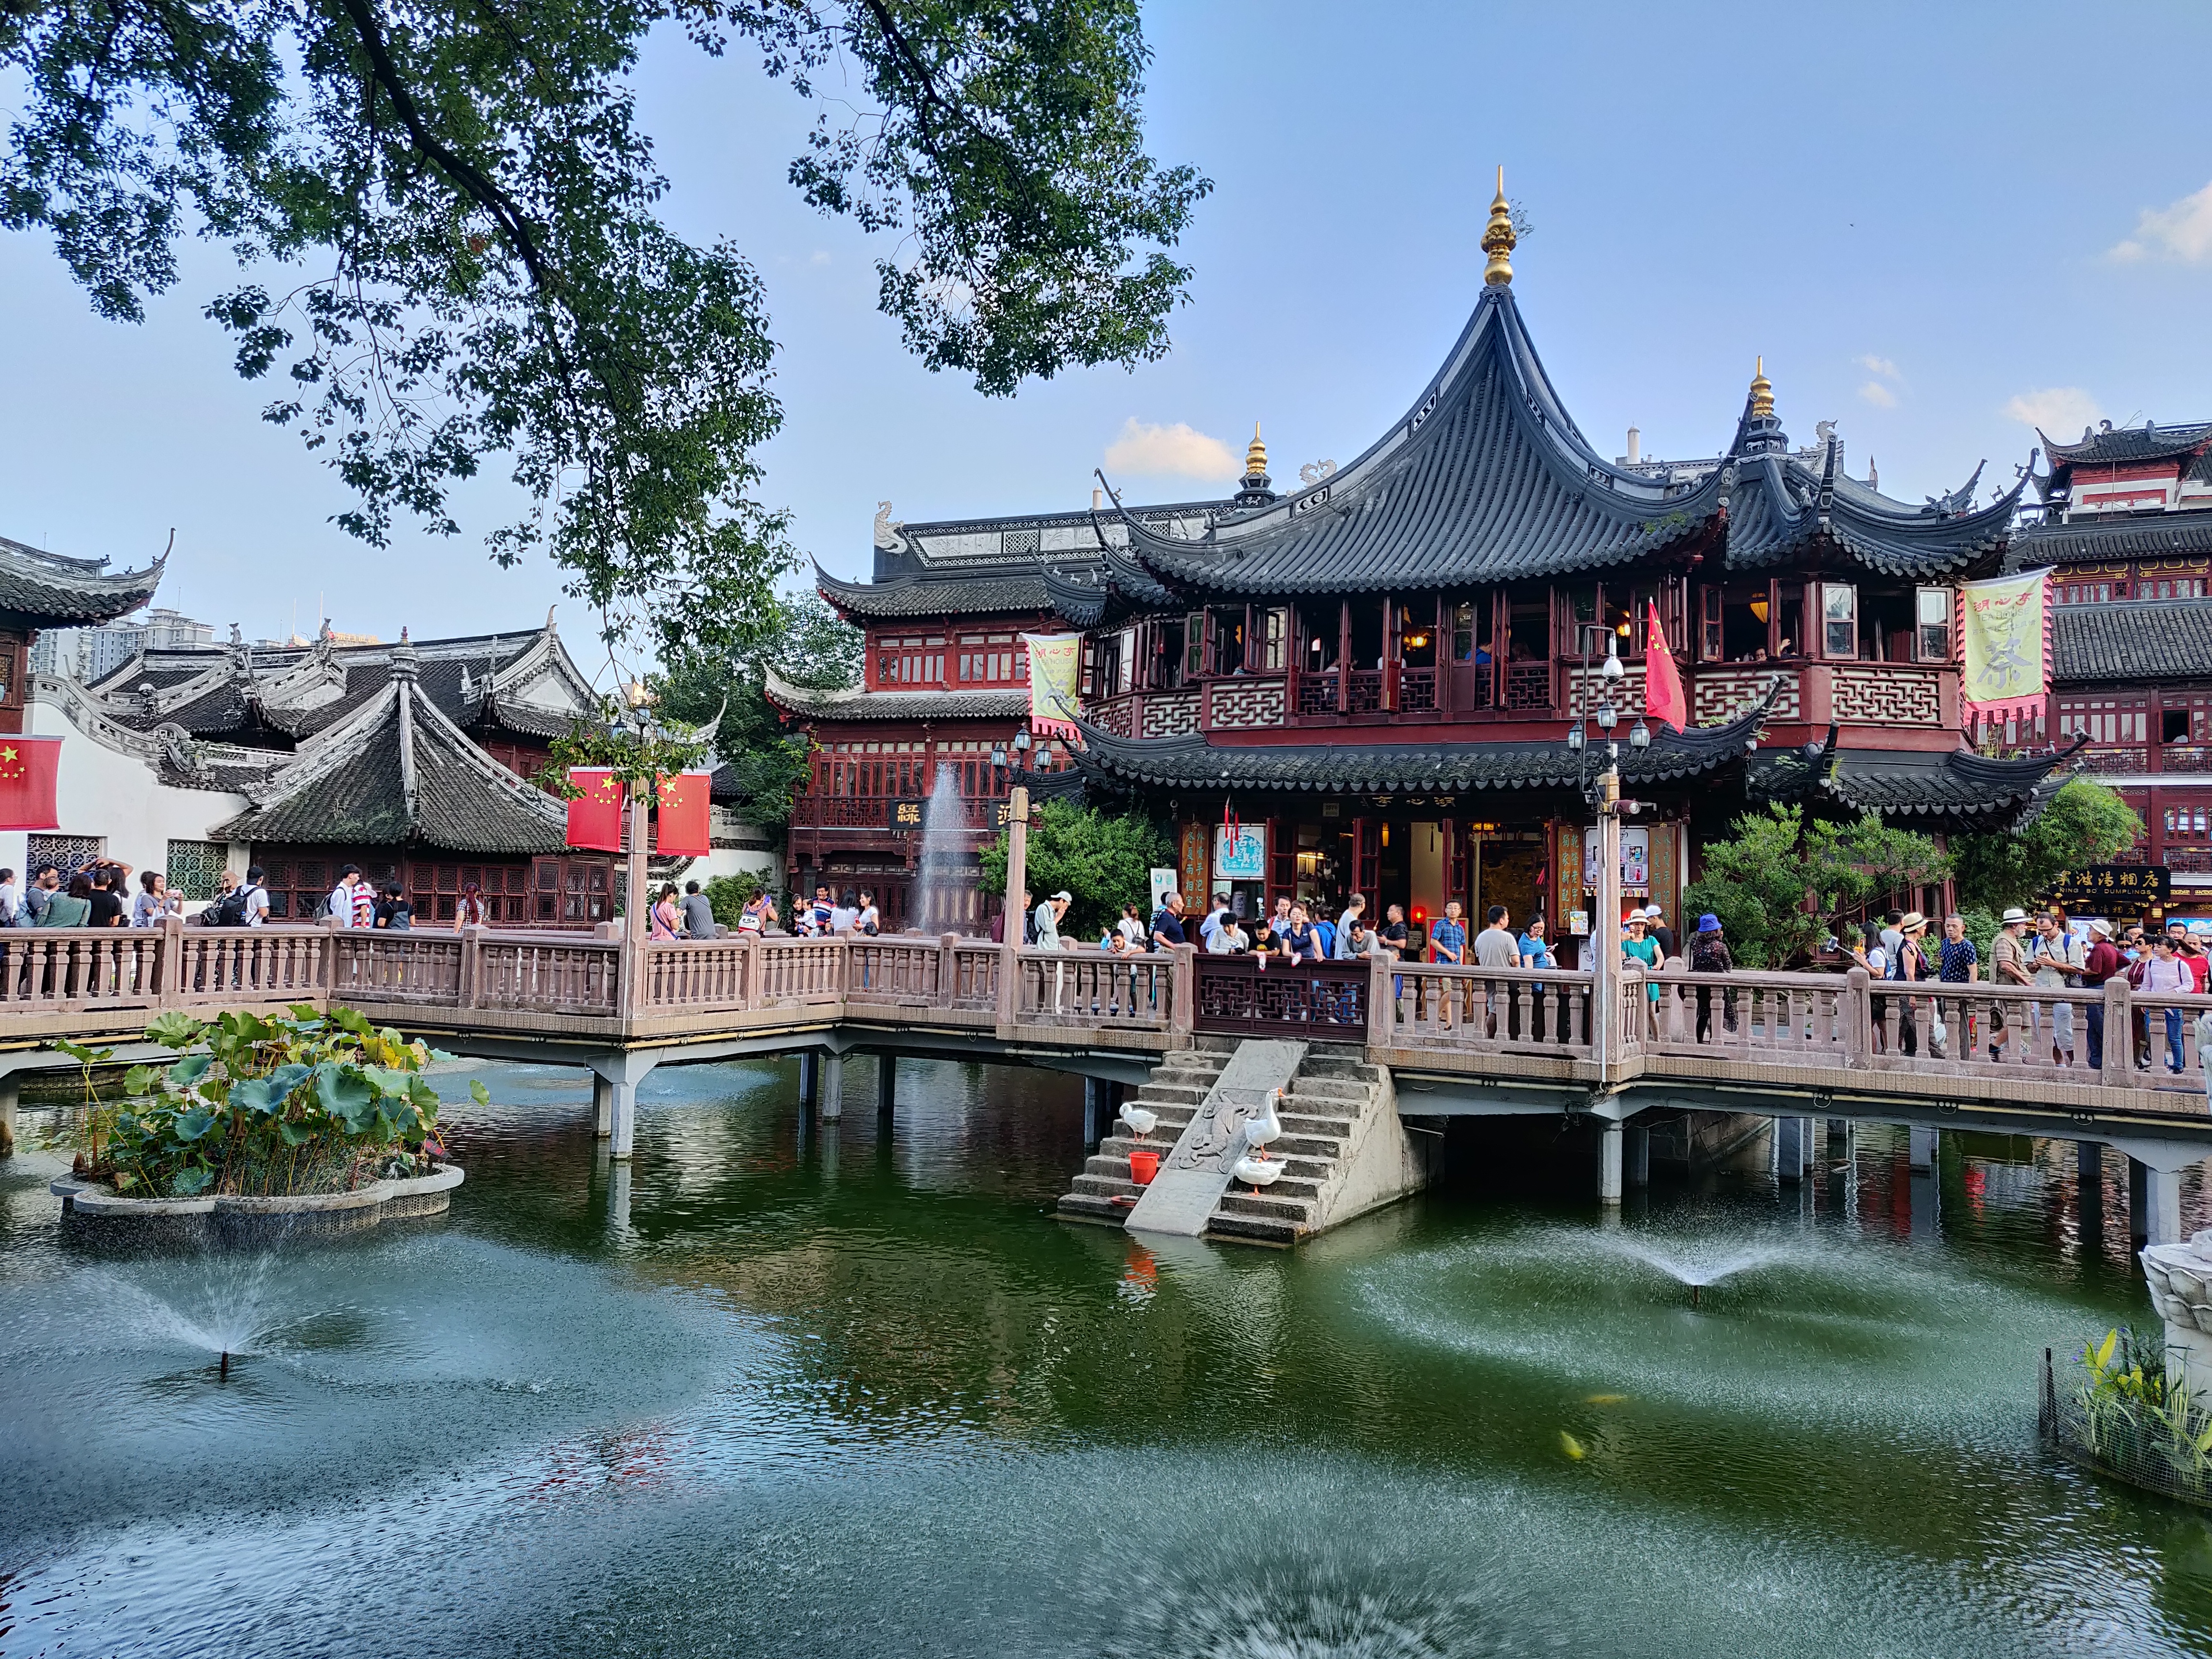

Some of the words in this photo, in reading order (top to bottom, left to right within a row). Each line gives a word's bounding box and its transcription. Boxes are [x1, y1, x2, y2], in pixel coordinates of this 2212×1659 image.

[1973, 592, 2034, 612] 湖心亭
[1977, 613, 1994, 622] TEA
[1996, 607, 2030, 620] HOUSE
[1035, 647, 1077, 658] 湖心亭
[1976, 637, 2033, 689] 茶
